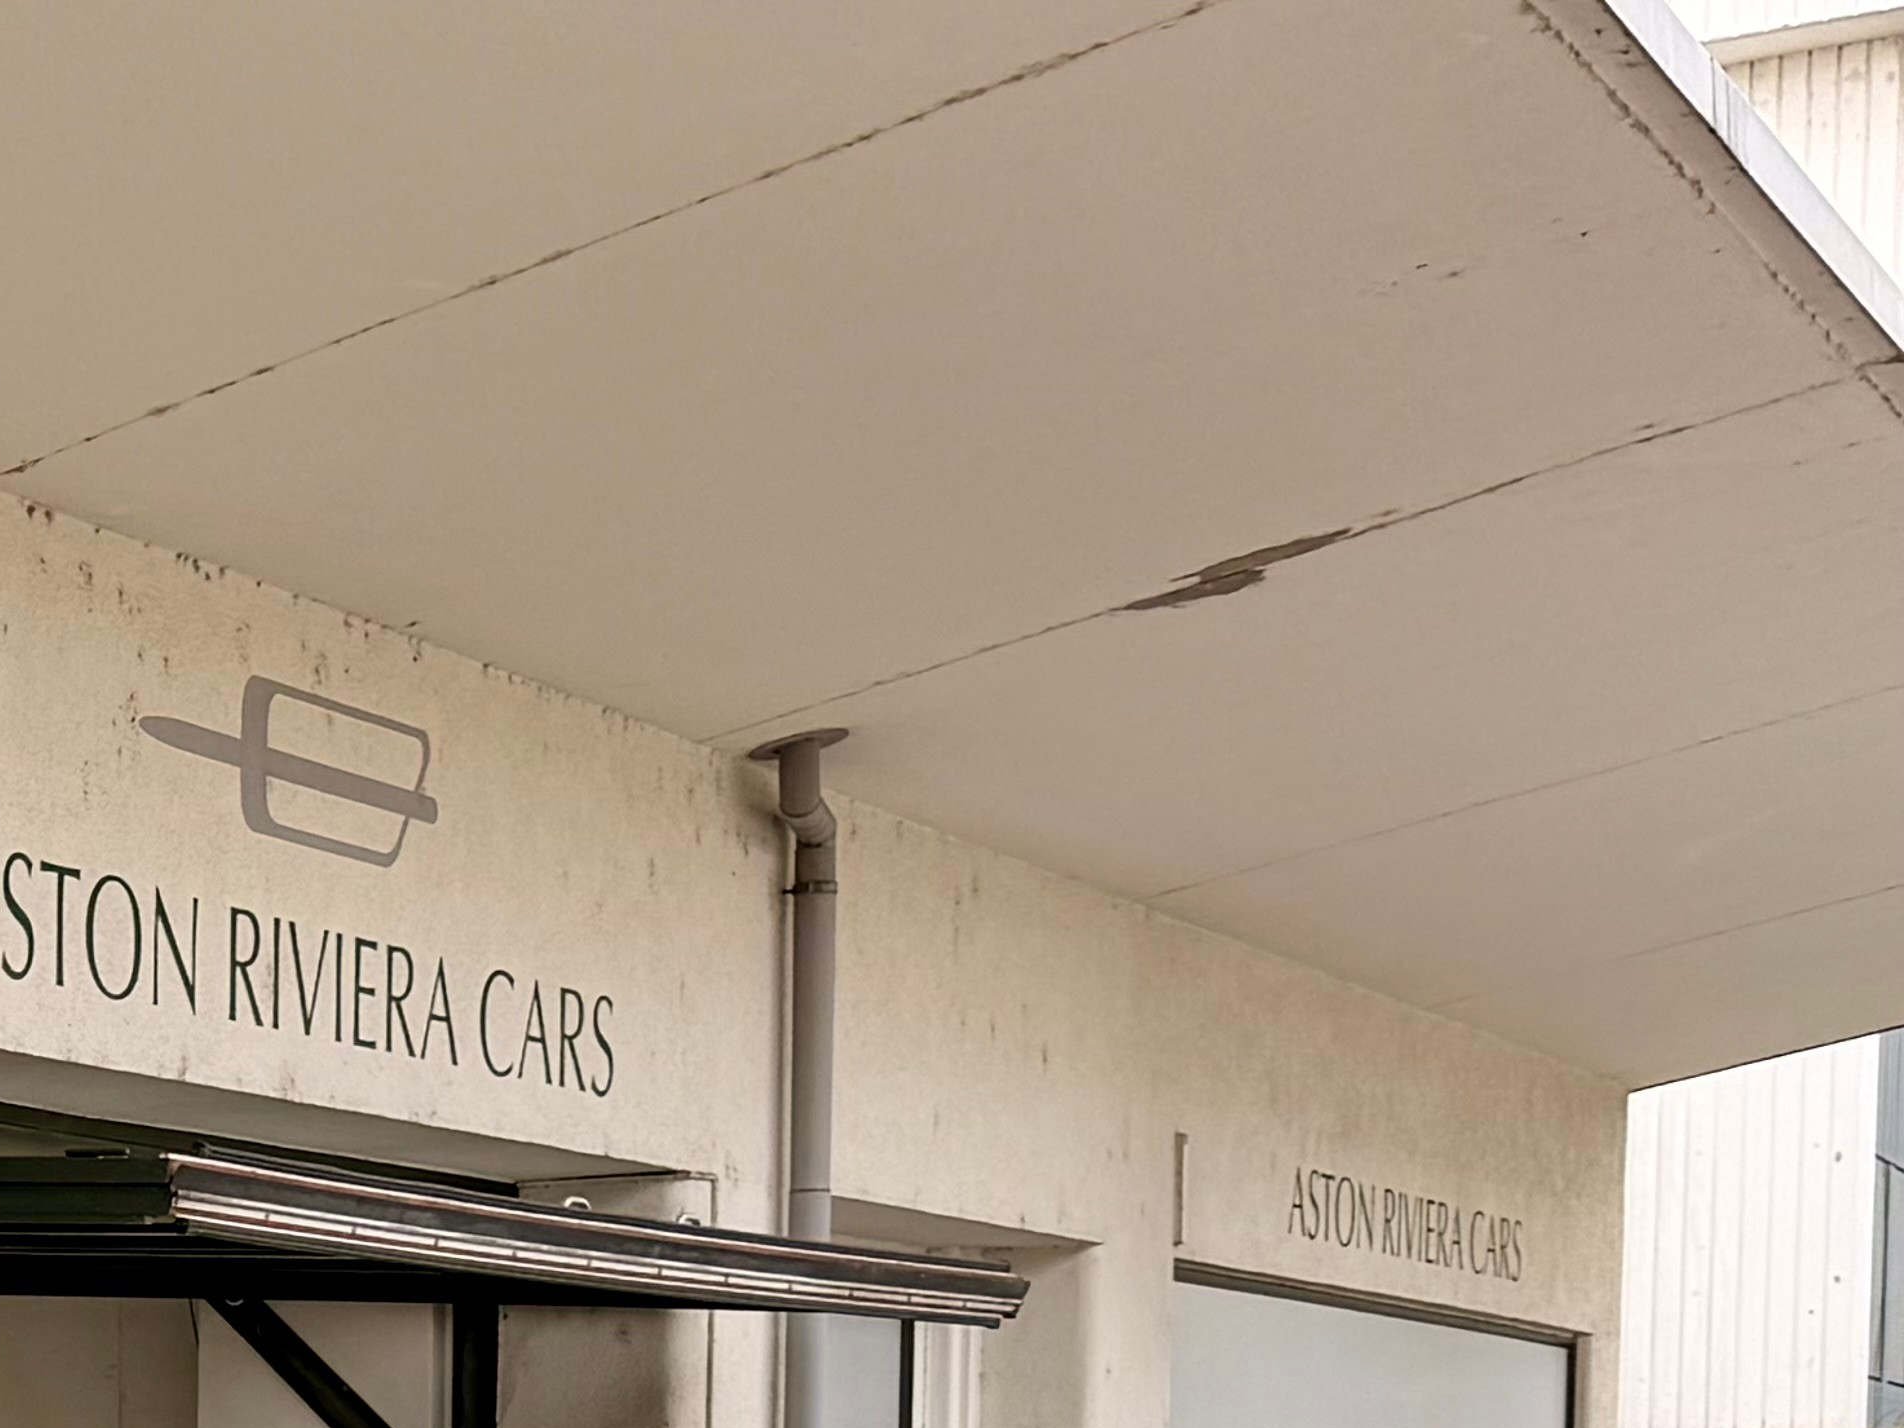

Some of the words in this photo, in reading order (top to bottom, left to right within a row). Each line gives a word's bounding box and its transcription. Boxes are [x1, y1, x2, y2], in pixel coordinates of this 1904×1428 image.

[228, 906, 459, 1067] RIVIERA
[479, 968, 615, 1098] CARS
[1288, 1166, 1376, 1252] ASTON
[1382, 1188, 1464, 1270] RIVIERA
[1470, 1210, 1523, 1282] CARS
